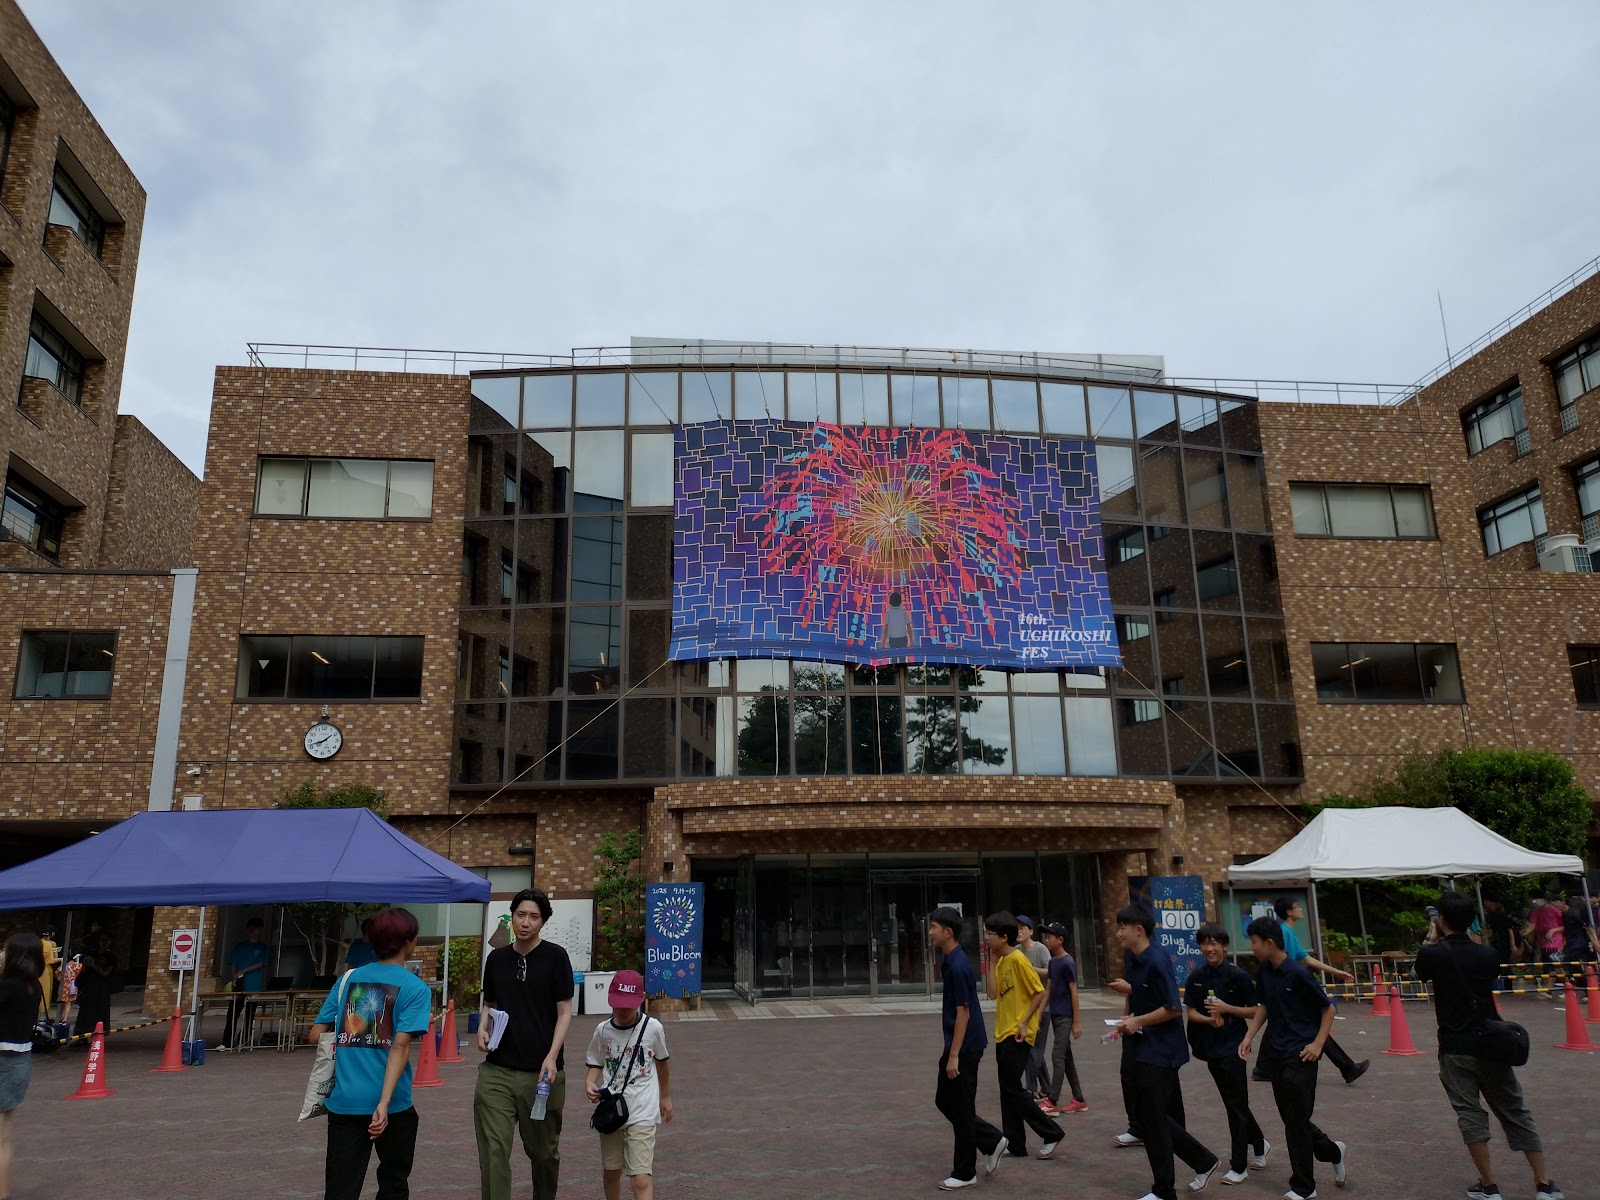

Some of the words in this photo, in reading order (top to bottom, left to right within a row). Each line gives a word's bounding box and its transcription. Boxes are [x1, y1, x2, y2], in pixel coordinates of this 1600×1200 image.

[1018, 613, 1048, 625] 46th
[1020, 629, 1112, 642] UCHIKOSHI
[1021, 646, 1049, 659] FES
[1160, 933, 1185, 946] Blue
[647, 947, 671, 963] Blue
[671, 944, 702, 961] Bloom
[1176, 944, 1203, 955] Bloo
[617, 983, 637, 993] LMU
[337, 1032, 361, 1044] Blue
